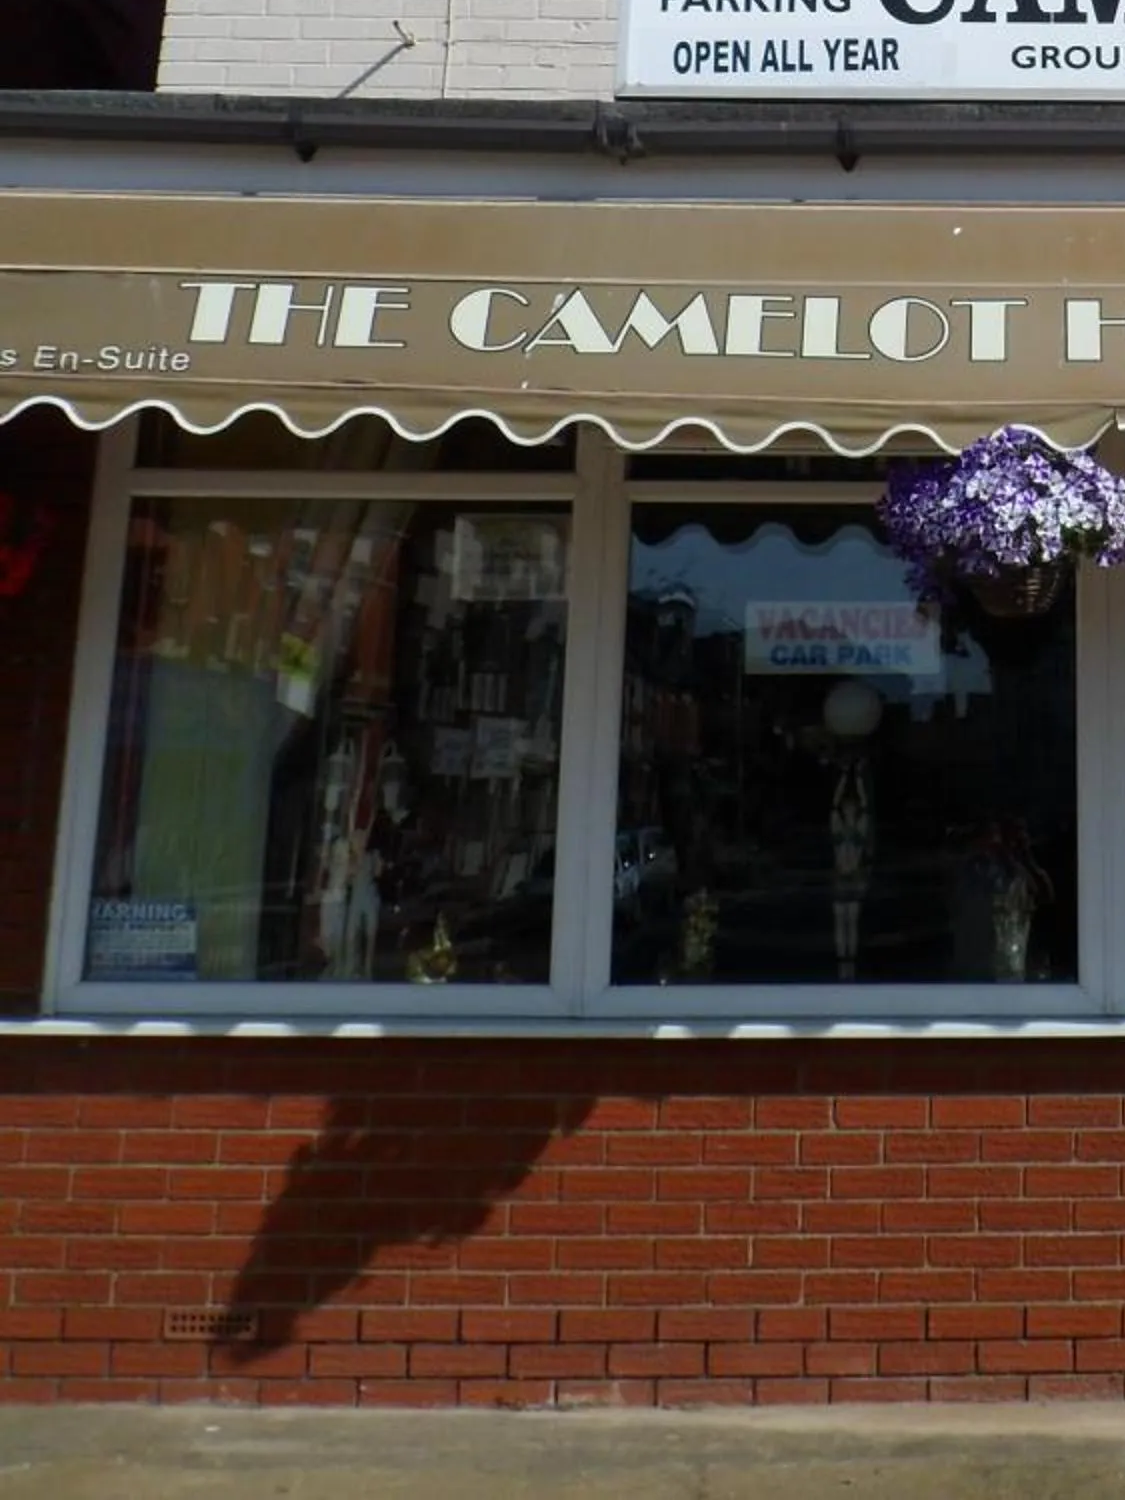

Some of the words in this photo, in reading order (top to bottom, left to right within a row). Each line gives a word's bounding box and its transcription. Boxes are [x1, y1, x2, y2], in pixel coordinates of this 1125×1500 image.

[673, 41, 751, 75] OPEN
[760, 40, 813, 73] ALL
[824, 38, 900, 72] YEAR
[181, 282, 409, 348] THE
[449, 288, 1028, 361] CAMELOT
[33, 345, 191, 371] En-Suite
[771, 645, 827, 666] CAR
[838, 644, 912, 666] PARK
